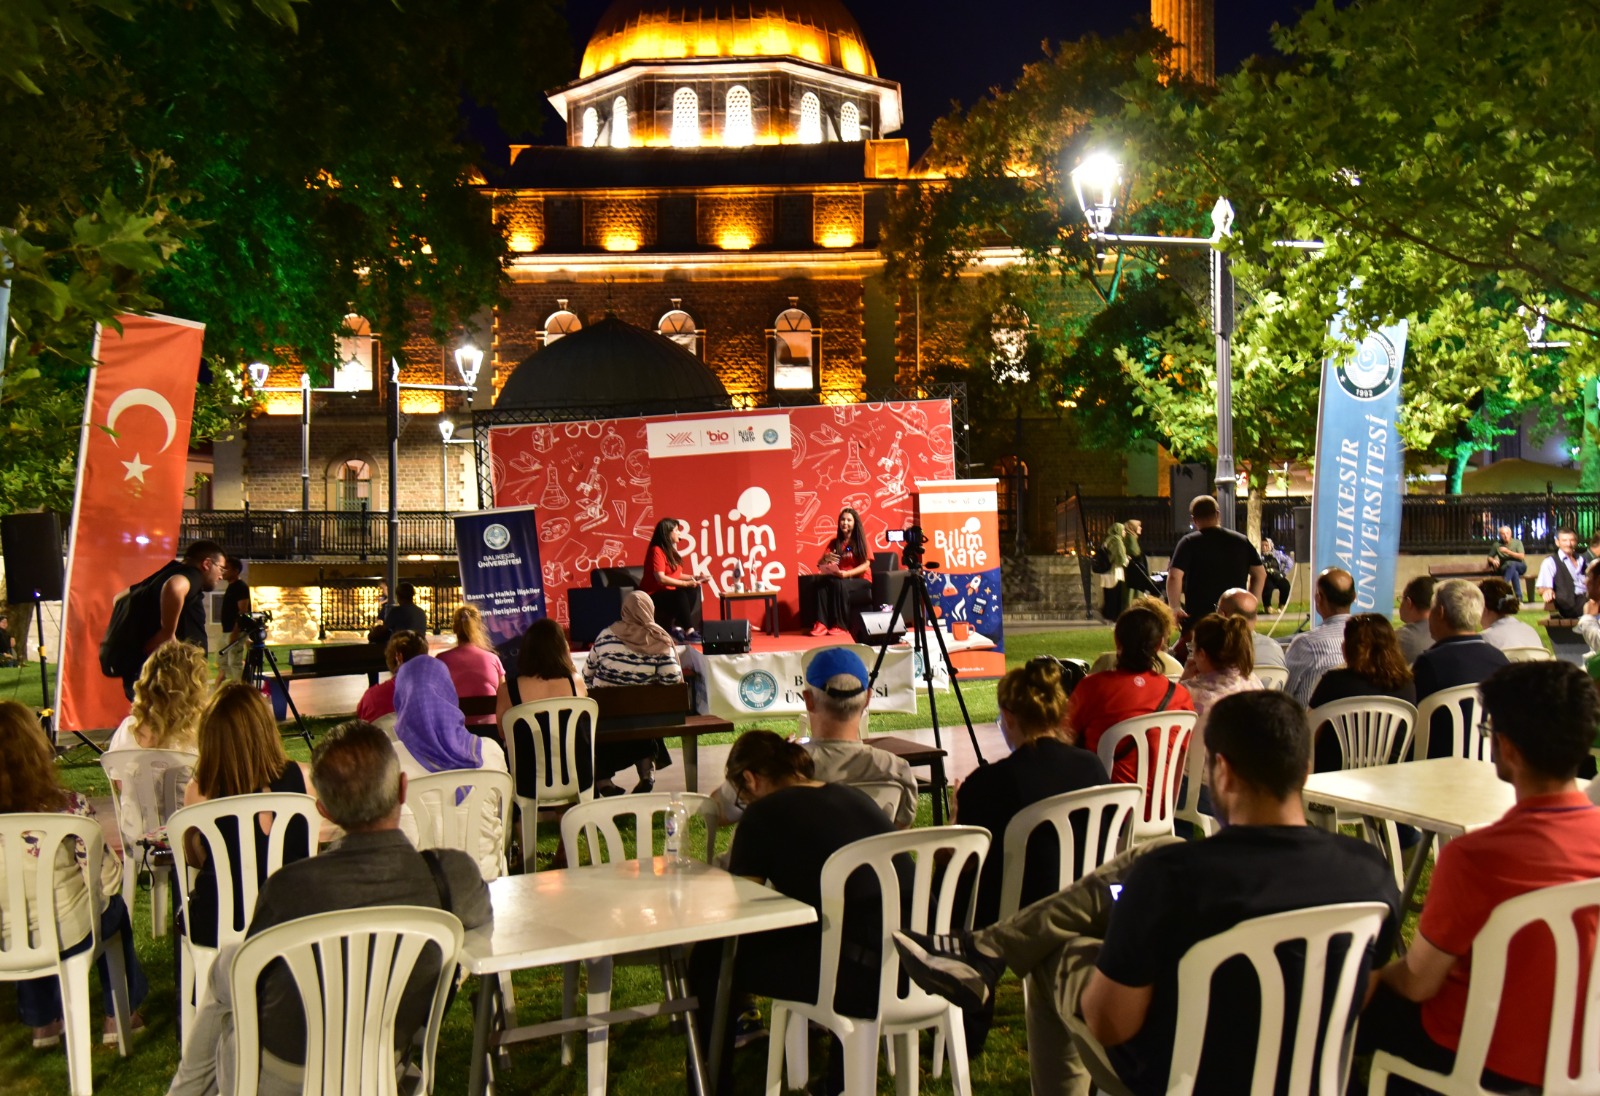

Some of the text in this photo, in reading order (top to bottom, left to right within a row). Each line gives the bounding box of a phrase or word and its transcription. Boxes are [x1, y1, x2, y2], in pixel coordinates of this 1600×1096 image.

[1335, 438, 1360, 570] ALIKESİR
[934, 527, 983, 549] Bilim
[495, 590, 516, 598] Halkla
[492, 606, 521, 615] İletişimi
[521, 604, 538, 612] Ofisi
